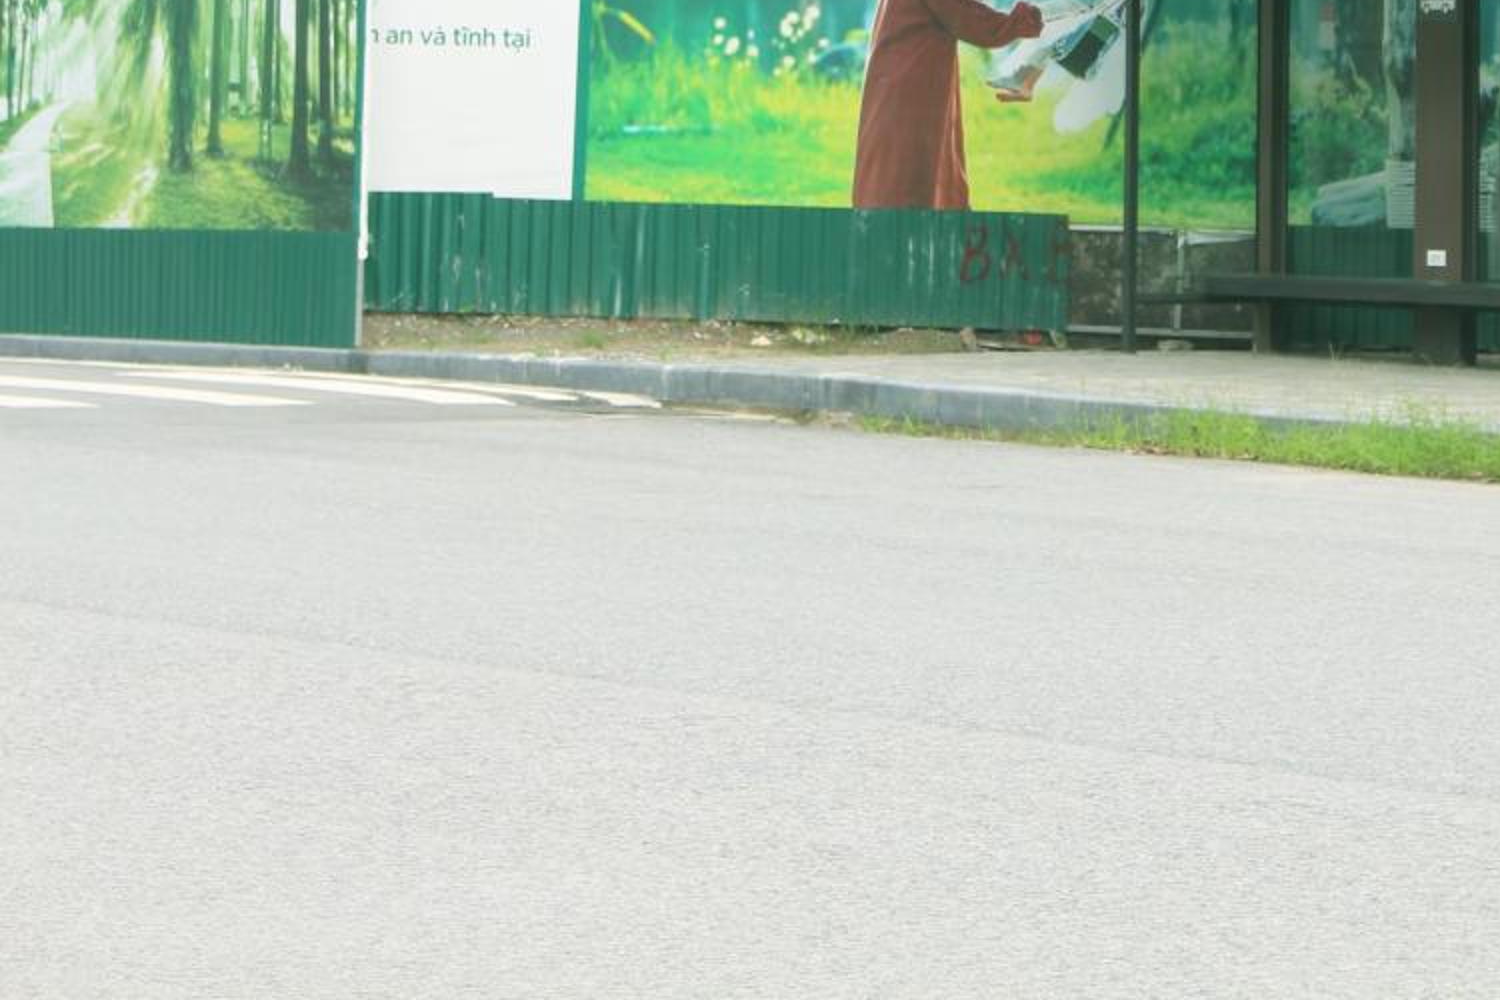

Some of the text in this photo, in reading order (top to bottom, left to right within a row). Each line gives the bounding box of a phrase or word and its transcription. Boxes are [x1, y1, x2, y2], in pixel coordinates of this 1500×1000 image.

[385, 29, 413, 45] an
[420, 24, 447, 46] và
[453, 25, 496, 47] tĩnh
[503, 28, 531, 53] tại
